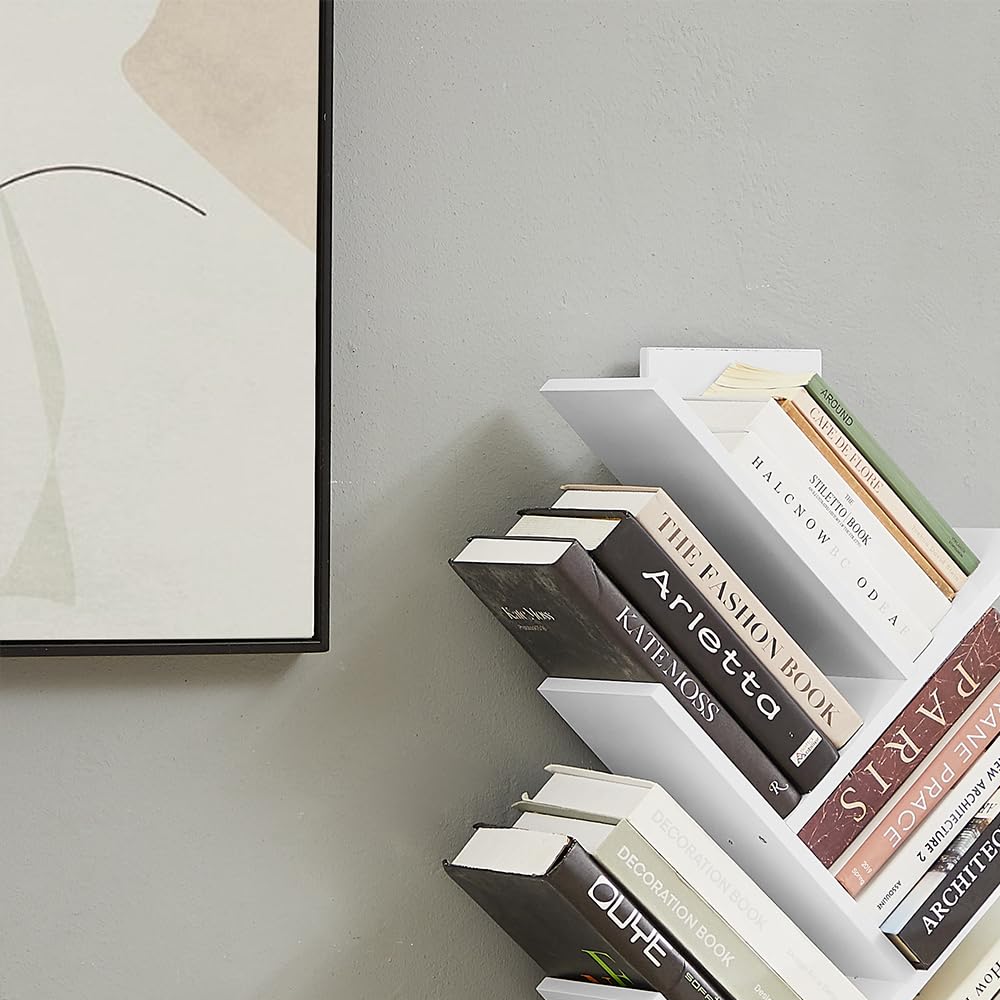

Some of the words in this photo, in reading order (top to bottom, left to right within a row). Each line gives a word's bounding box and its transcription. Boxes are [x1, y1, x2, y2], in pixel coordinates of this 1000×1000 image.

[809, 407, 837, 440] CAFE
[834, 436, 852, 457] DE
[849, 453, 884, 494] FLORE
[819, 389, 854, 427] AROUND
[809, 474, 848, 519] STILETTO
[846, 517, 872, 546] BOOK
[615, 605, 674, 668] KATE
[661, 659, 720, 724] MOSS
[642, 568, 783, 721] Arletta
[656, 511, 704, 568] THE
[699, 564, 784, 661] FASHON
[780, 655, 843, 728] BOOK
[840, 660, 981, 823] PARIS
[883, 761, 956, 849] PRACE
[926, 778, 987, 853] ARCHITECTURE
[916, 851, 927, 862] 2
[587, 874, 667, 968] OUYE
[616, 845, 698, 930] DECORATION
[694, 925, 736, 968] BOOK
